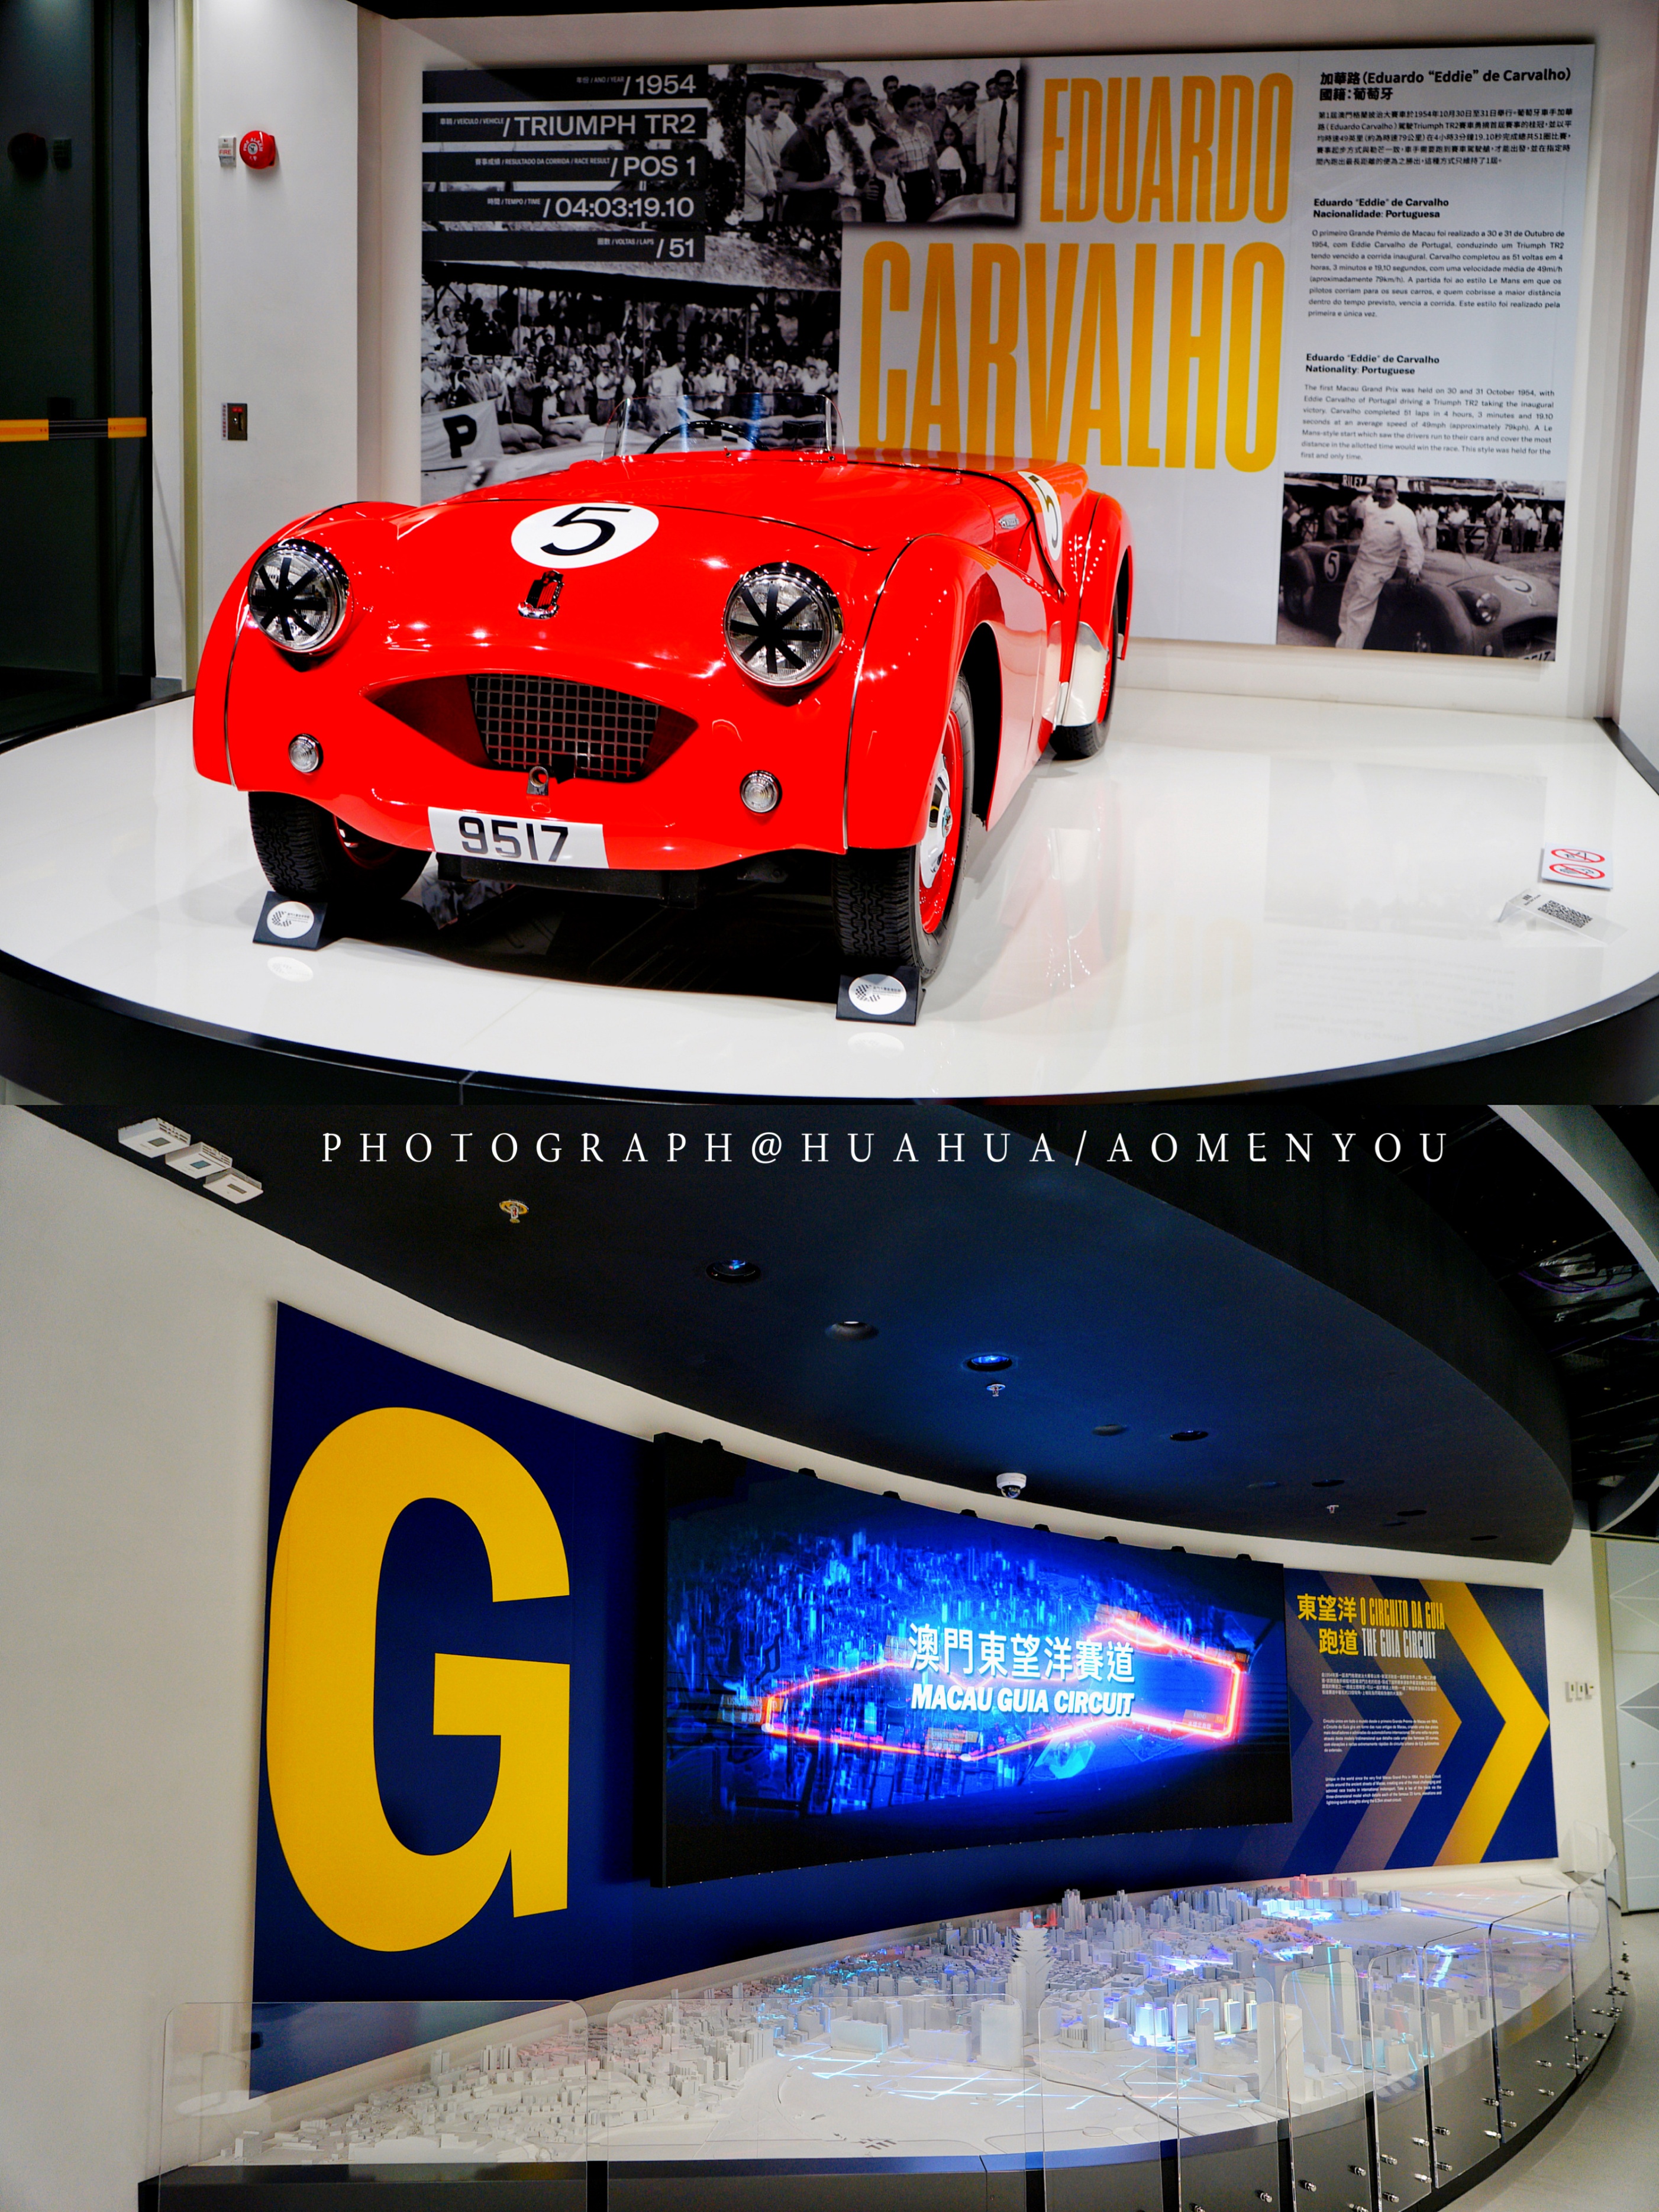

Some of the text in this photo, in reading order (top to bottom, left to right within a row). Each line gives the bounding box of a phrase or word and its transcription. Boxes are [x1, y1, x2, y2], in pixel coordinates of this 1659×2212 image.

[636, 75, 696, 94] 1954
[1483, 70, 1500, 82] de
[514, 115, 635, 136] TRIUMPH
[645, 114, 696, 134] TR2
[1040, 73, 1293, 224] EDUARDO
[624, 156, 677, 176] POS
[686, 157, 696, 176] 1
[556, 197, 694, 218] 04:03:19.10
[1386, 209, 1439, 219] Portuguesa
[1391, 198, 1403, 206] de
[1405, 198, 1448, 206] Carvalho
[669, 238, 694, 258] 51
[858, 241, 1285, 472] CARVALHO
[1396, 355, 1439, 363] Carvalho
[1305, 365, 1415, 376] Nationality: Portuguese
[1368, 396, 1396, 405] Portugal
[443, 413, 478, 459] P
[1342, 475, 1363, 488] RILEY
[540, 507, 631, 556] 5
[1326, 553, 1338, 578] 5
[459, 815, 569, 863] 9517
[1297, 1593, 1357, 1623] 東望洋
[1361, 1597, 1445, 1630] O CIRCUITO DA GUIA
[908, 1623, 1135, 1683] 澳門東望洋賽道
[1319, 1629, 1358, 1656] 跑道
[1361, 1628, 1436, 1659] THE GUIA CIRCUIT
[266, 1406, 570, 1952] G
[911, 1683, 1135, 1716] MACAU GUIA CIRCUIT
